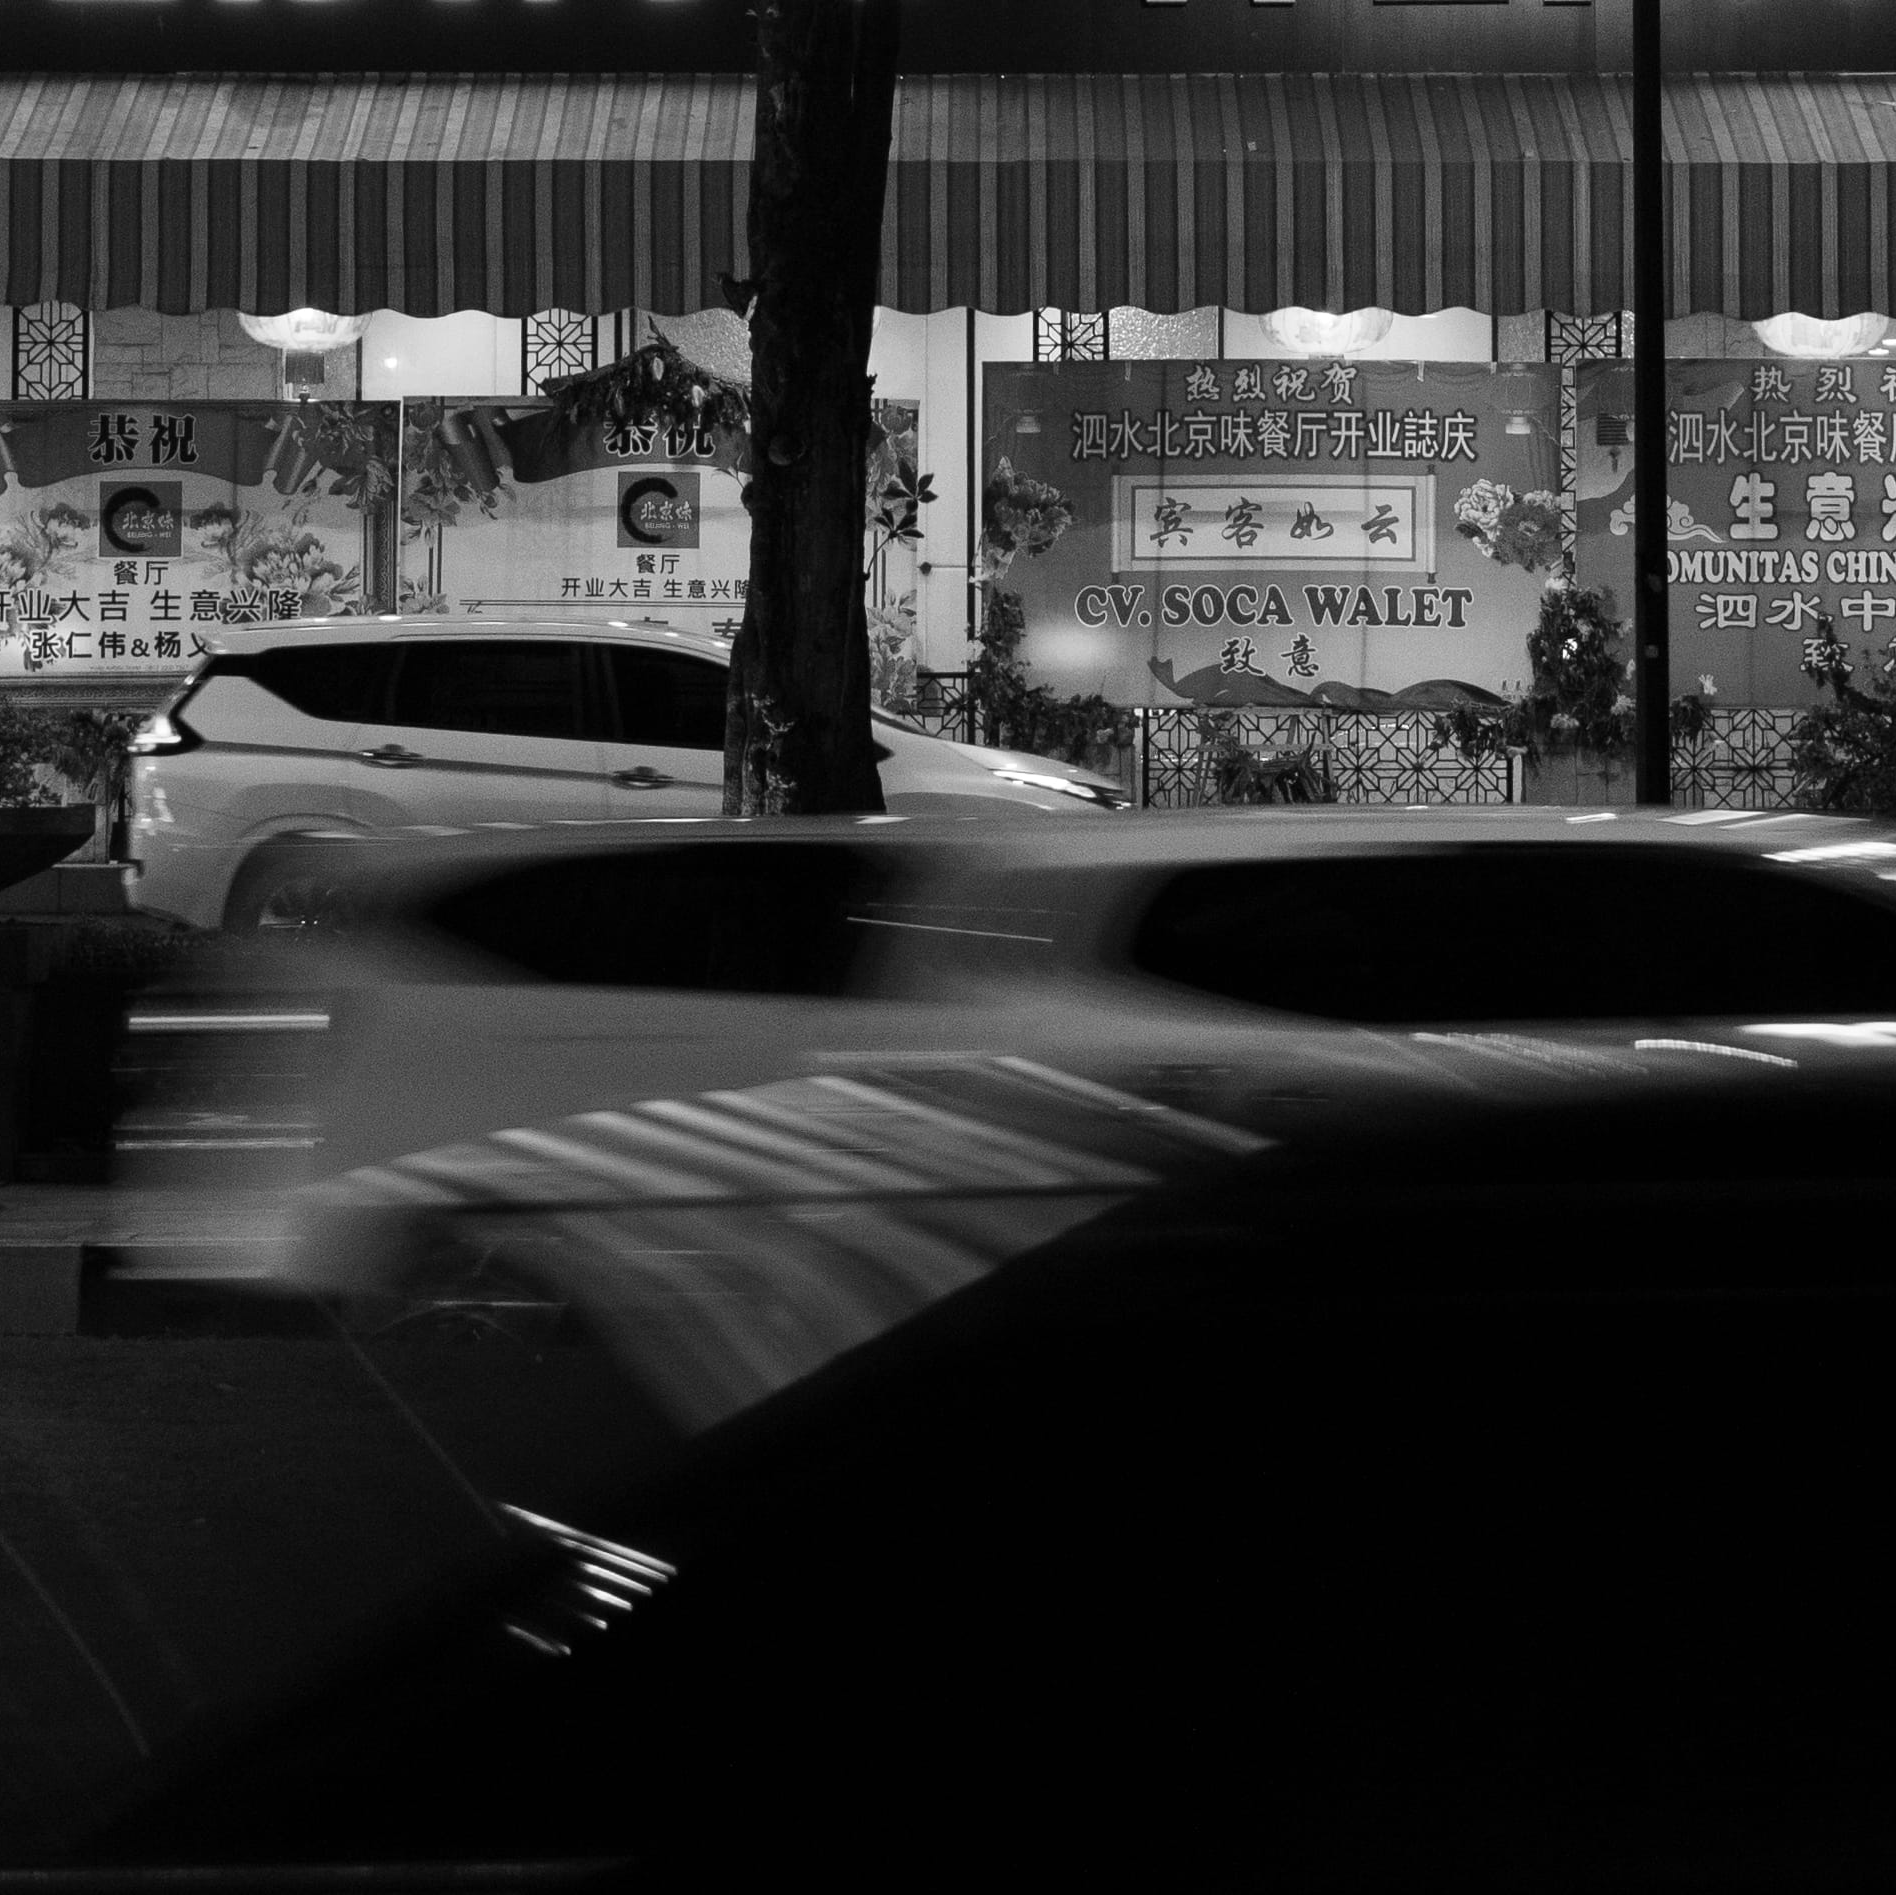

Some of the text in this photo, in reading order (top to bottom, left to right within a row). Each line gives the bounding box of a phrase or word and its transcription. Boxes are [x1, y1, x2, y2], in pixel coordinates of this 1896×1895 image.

[1186, 363, 1359, 403] 热烈祝贺
[88, 413, 199, 464] 恭祝
[1072, 410, 1476, 460] 泗水北京味餐厅开业誌庆
[1150, 496, 1400, 549] 宾客如云
[114, 561, 169, 585] 餐厅
[636, 554, 680, 575] 餐厅
[1667, 550, 1819, 584] OMUNITAS
[150, 589, 303, 622] 生意兴隆
[561, 578, 652, 598] 开业大吉
[1075, 586, 1473, 629] CV. SOCA WALET
[1221, 633, 1319, 678] 致意
